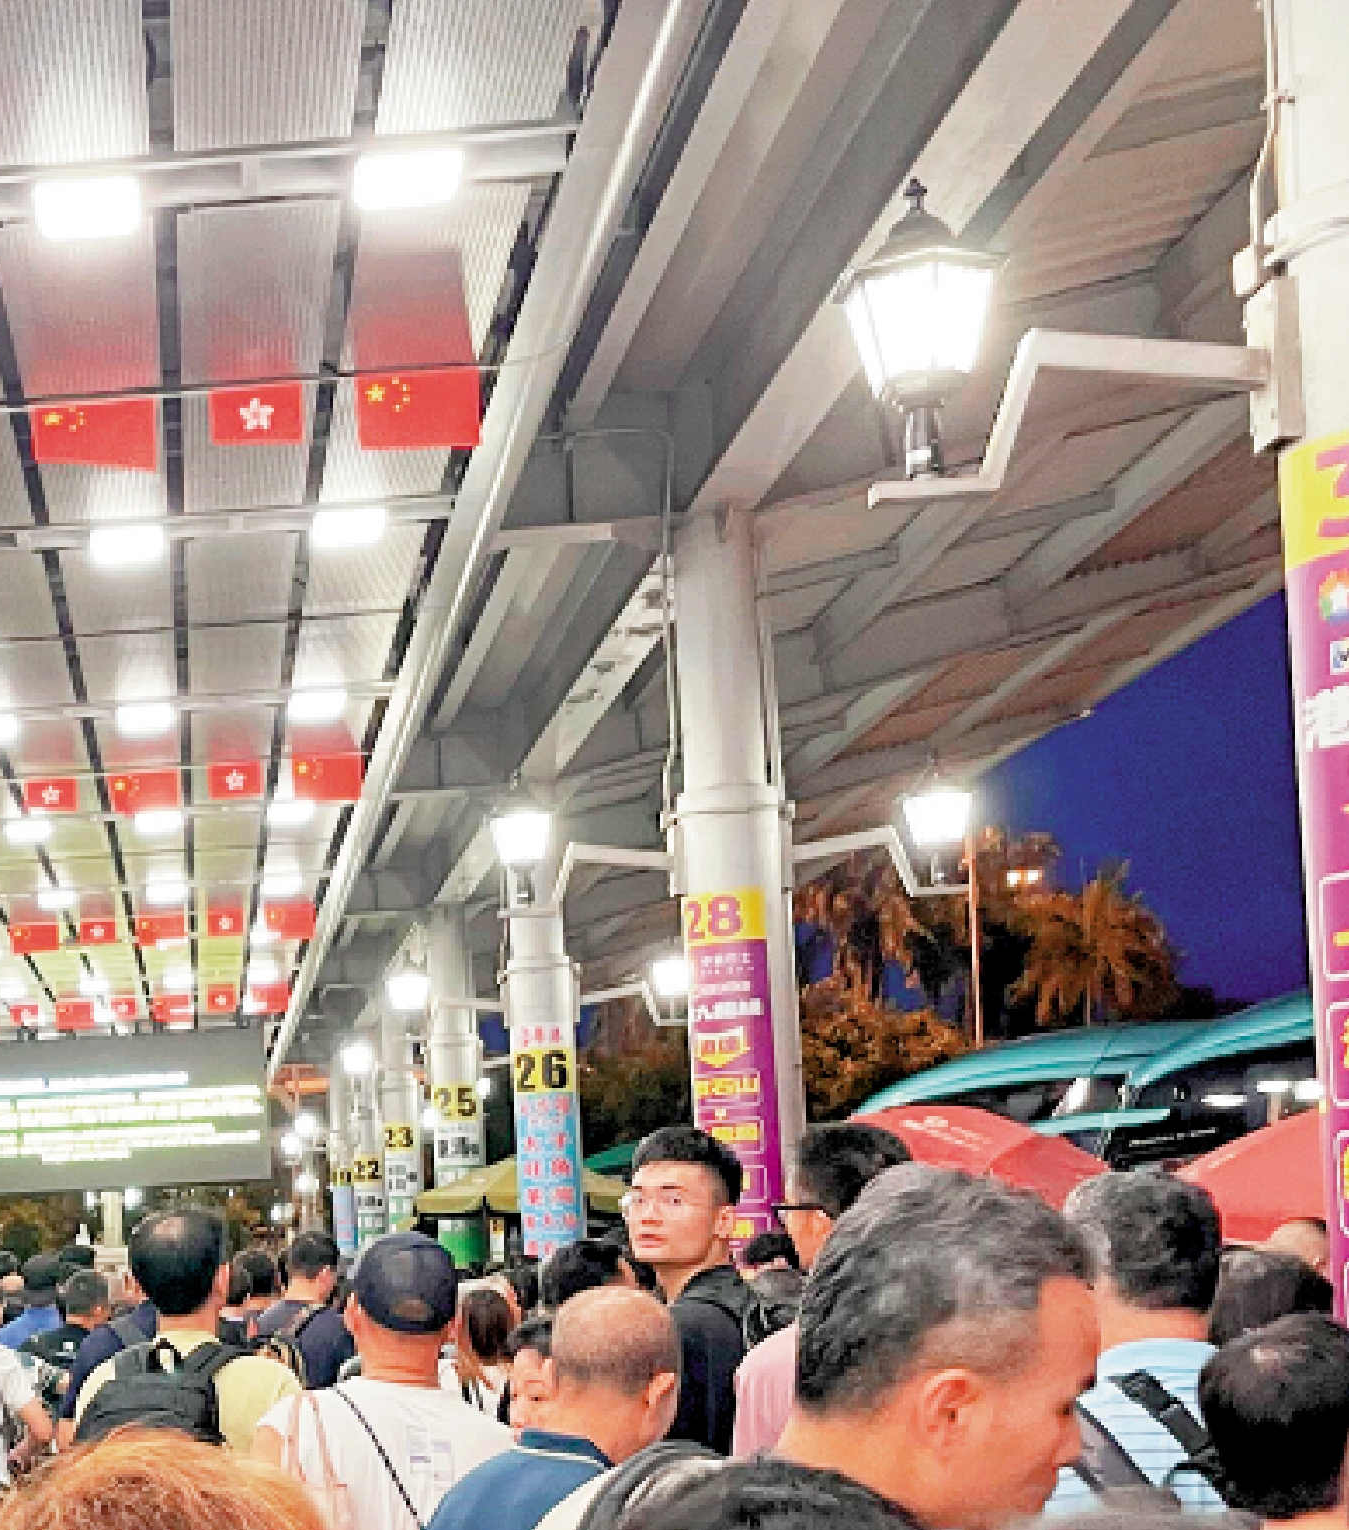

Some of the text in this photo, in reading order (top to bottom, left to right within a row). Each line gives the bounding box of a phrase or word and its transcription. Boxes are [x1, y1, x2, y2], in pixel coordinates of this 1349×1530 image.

[687, 895, 742, 940] 28
[516, 1050, 568, 1092] 26
[434, 1087, 476, 1116] 25
[385, 1127, 413, 1148] 23
[354, 1158, 380, 1180] 22
